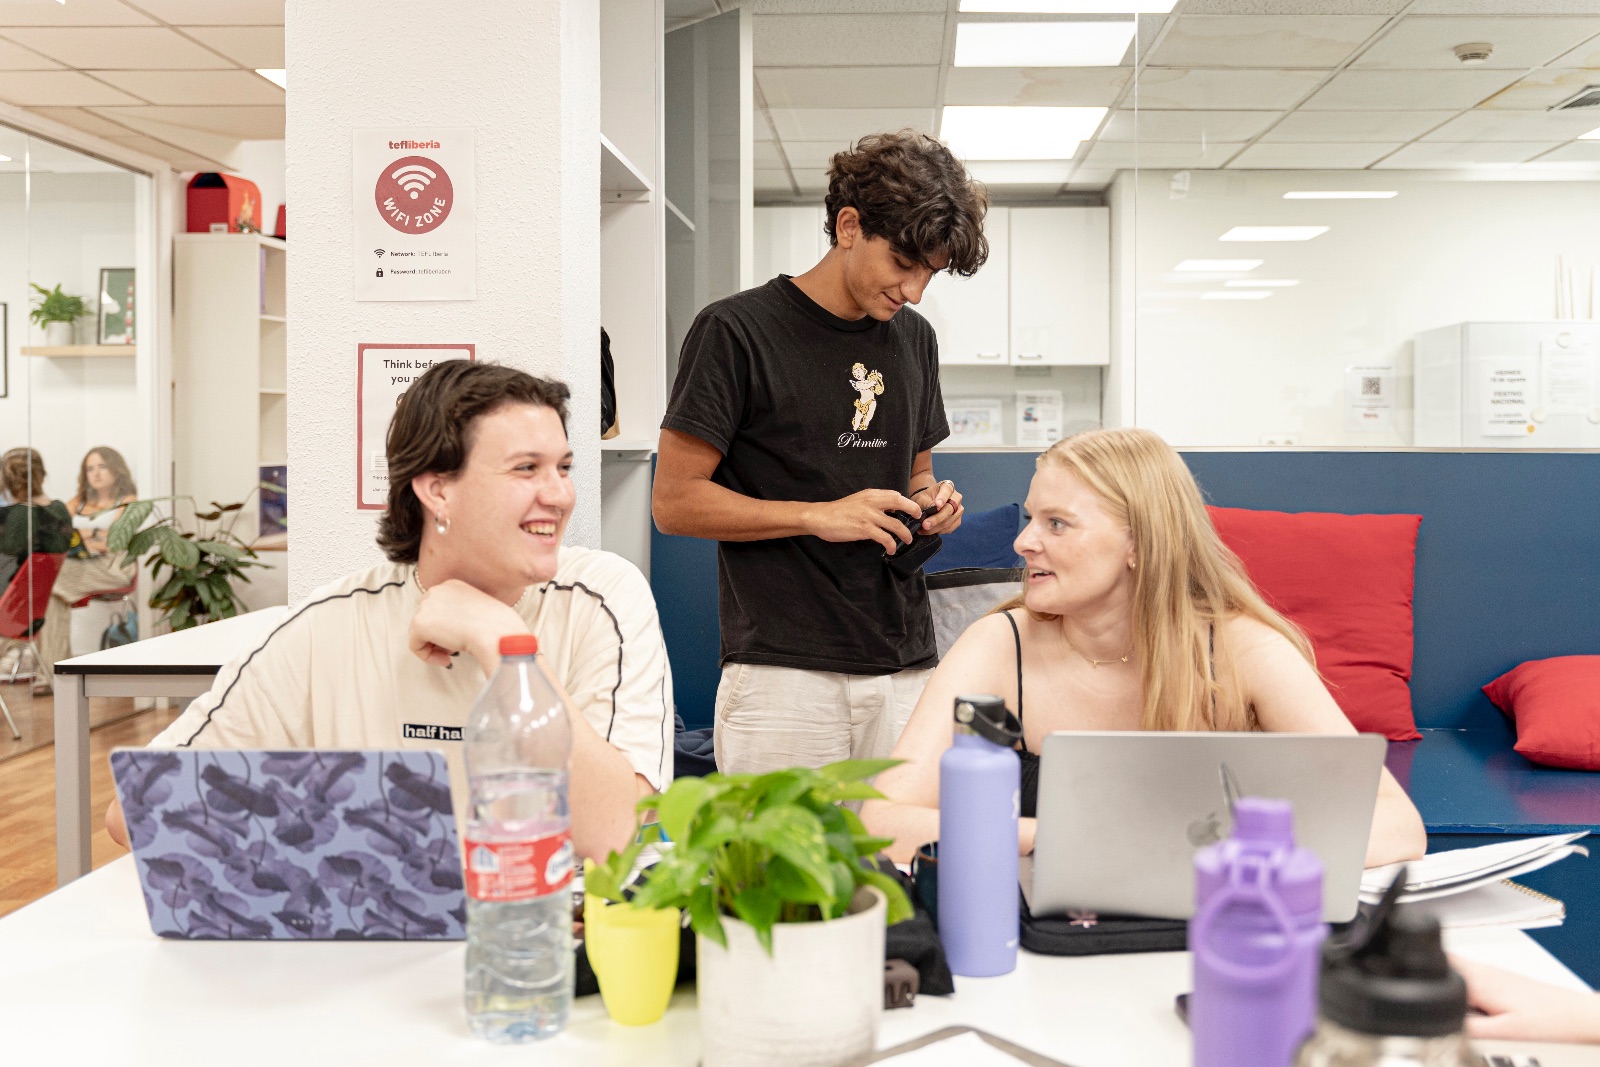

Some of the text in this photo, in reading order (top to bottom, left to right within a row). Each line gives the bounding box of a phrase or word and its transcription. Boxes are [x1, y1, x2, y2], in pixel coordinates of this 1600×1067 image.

[388, 140, 441, 149] tefliberia
[383, 197, 446, 228] WIFI ZONE
[383, 360, 412, 368] Think
[391, 376, 410, 386] you
[838, 432, 888, 448] Primitive
[405, 724, 437, 738] half
